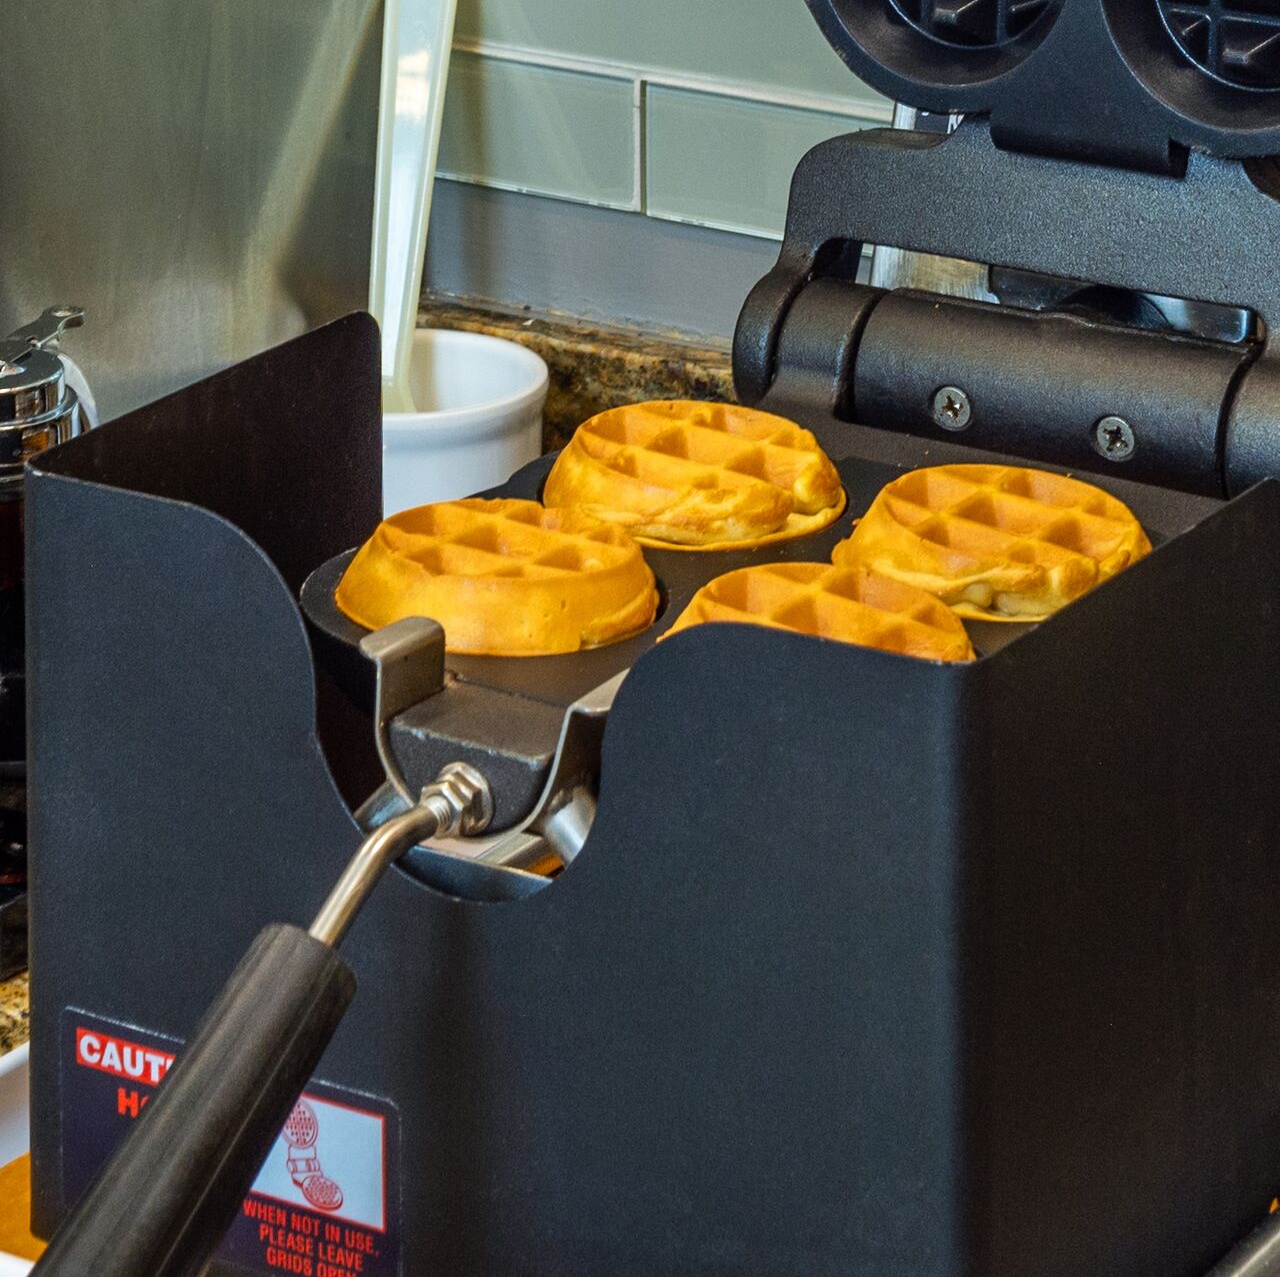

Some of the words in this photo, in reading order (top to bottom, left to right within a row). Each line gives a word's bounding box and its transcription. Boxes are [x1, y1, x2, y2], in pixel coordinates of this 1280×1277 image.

[243, 1199, 287, 1228] WHEN
[290, 1212, 320, 1236] NOT
[324, 1223, 340, 1244] IN
[344, 1229, 380, 1258] USE,
[260, 1223, 314, 1256] PLEASE
[318, 1242, 364, 1272] LEAVE
[266, 1246, 313, 1276] GRIDS
